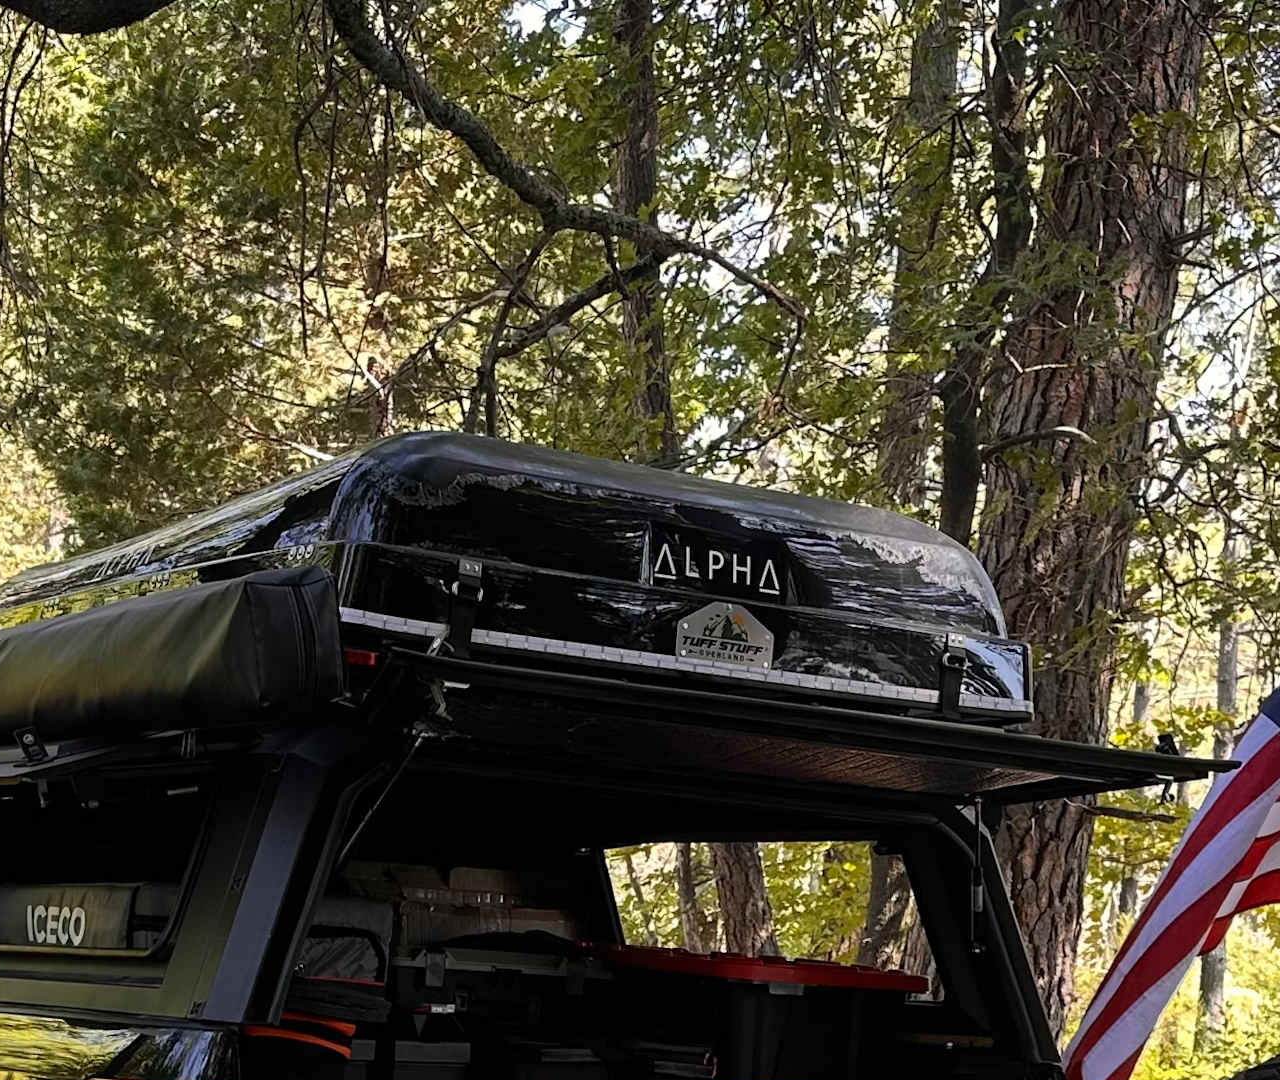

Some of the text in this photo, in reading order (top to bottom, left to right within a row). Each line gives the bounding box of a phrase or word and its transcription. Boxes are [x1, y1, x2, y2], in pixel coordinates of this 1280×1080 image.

[653, 543, 780, 595] ALPHA
[682, 635, 764, 656] TUFF STUFF
[26, 904, 86, 946] ICECO
